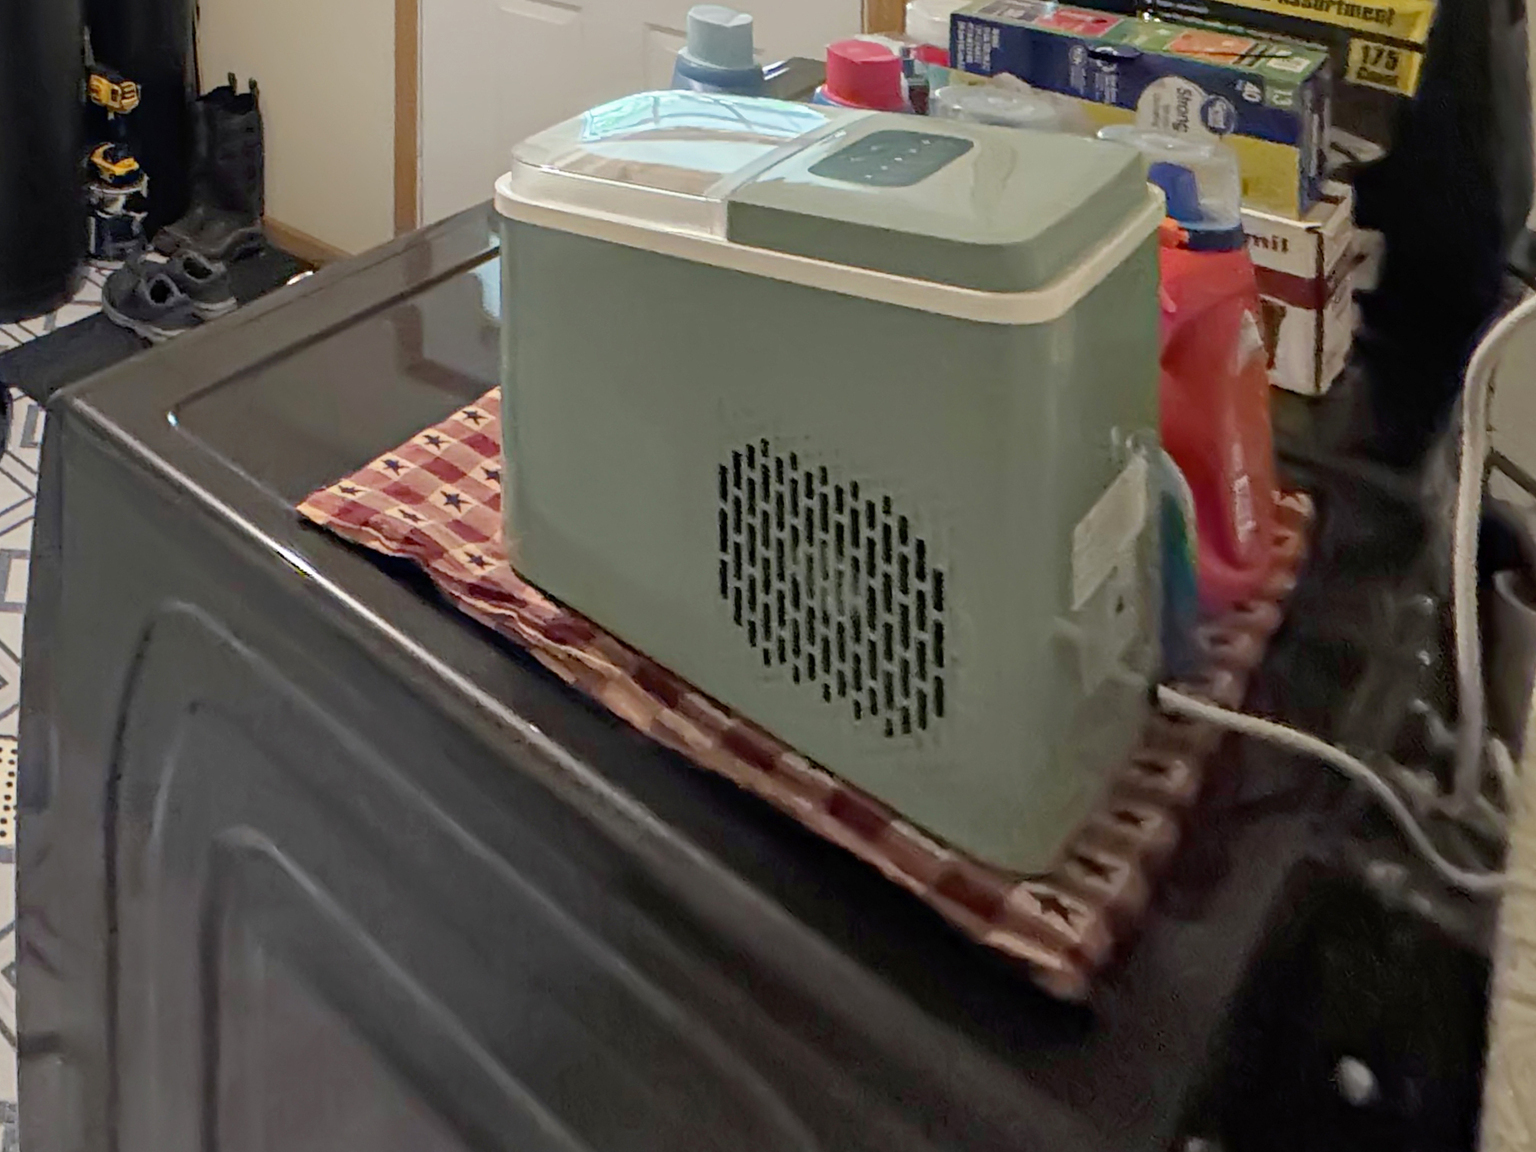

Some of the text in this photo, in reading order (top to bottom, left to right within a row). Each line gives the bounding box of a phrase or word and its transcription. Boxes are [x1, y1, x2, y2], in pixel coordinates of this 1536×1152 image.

[1361, 44, 1400, 71] 175
[1242, 81, 1262, 102] 40
[1272, 89, 1293, 105] 13
[1172, 86, 1192, 133] Strong
